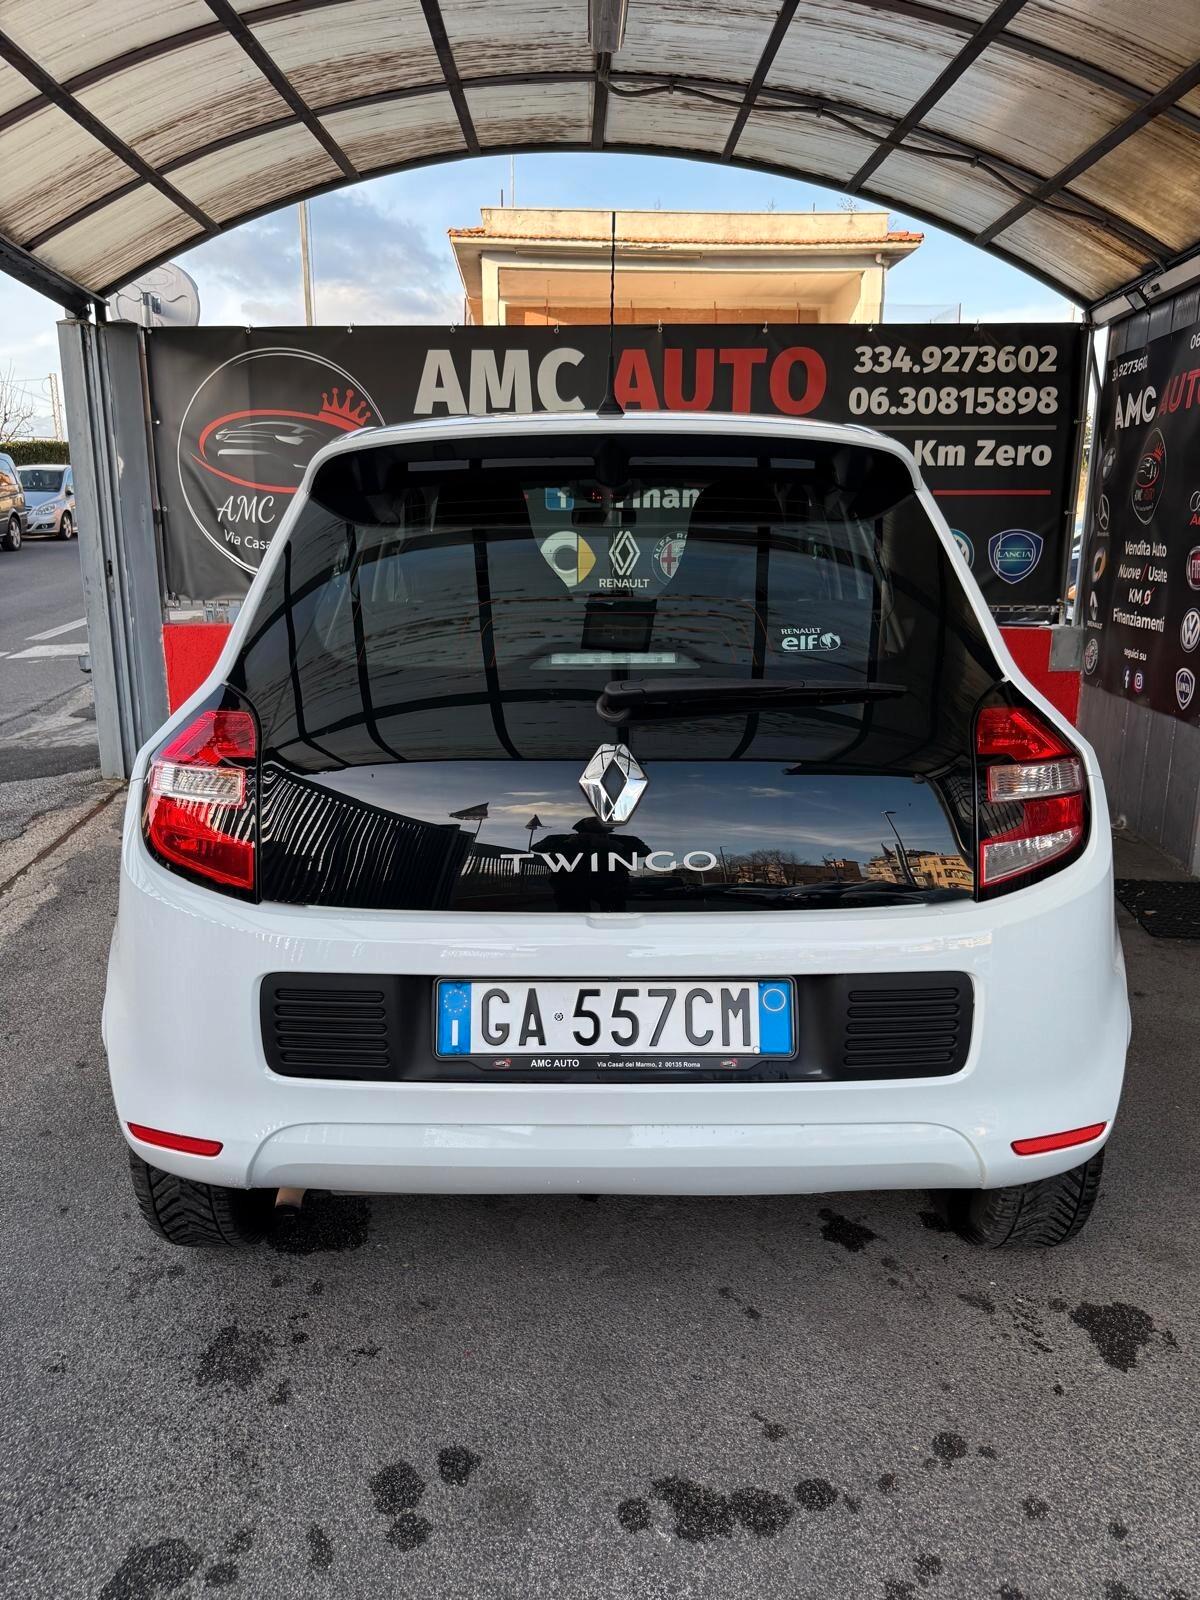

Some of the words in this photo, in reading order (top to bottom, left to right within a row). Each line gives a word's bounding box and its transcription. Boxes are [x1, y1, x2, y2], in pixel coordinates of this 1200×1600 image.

[853, 346, 1058, 374] 334.9273602
[413, 348, 586, 414] AMC
[611, 347, 827, 414] AUTO
[848, 387, 1059, 415] 06.30815898
[1115, 385, 1157, 430] AMC
[914, 440, 966, 467] Km
[974, 440, 1052, 467] Zero
[217, 495, 275, 524] AMC
[224, 529, 241, 546] Via
[1125, 540, 1151, 556] Vendita
[1152, 542, 1167, 557] Auto
[599, 578, 650, 588] RENAULT
[1118, 564, 1141, 580] Nuove
[1148, 566, 1168, 583] Usate
[1128, 588, 1143, 604] KM
[781, 627, 821, 635] RENAULT
[1112, 607, 1165, 633] Finanziamenti
[782, 635, 818, 650] elf
[500, 851, 717, 873] TWINGO
[481, 988, 547, 1046] GA
[530, 1060, 552, 1068] AMC
[553, 1060, 580, 1068] AUTO
